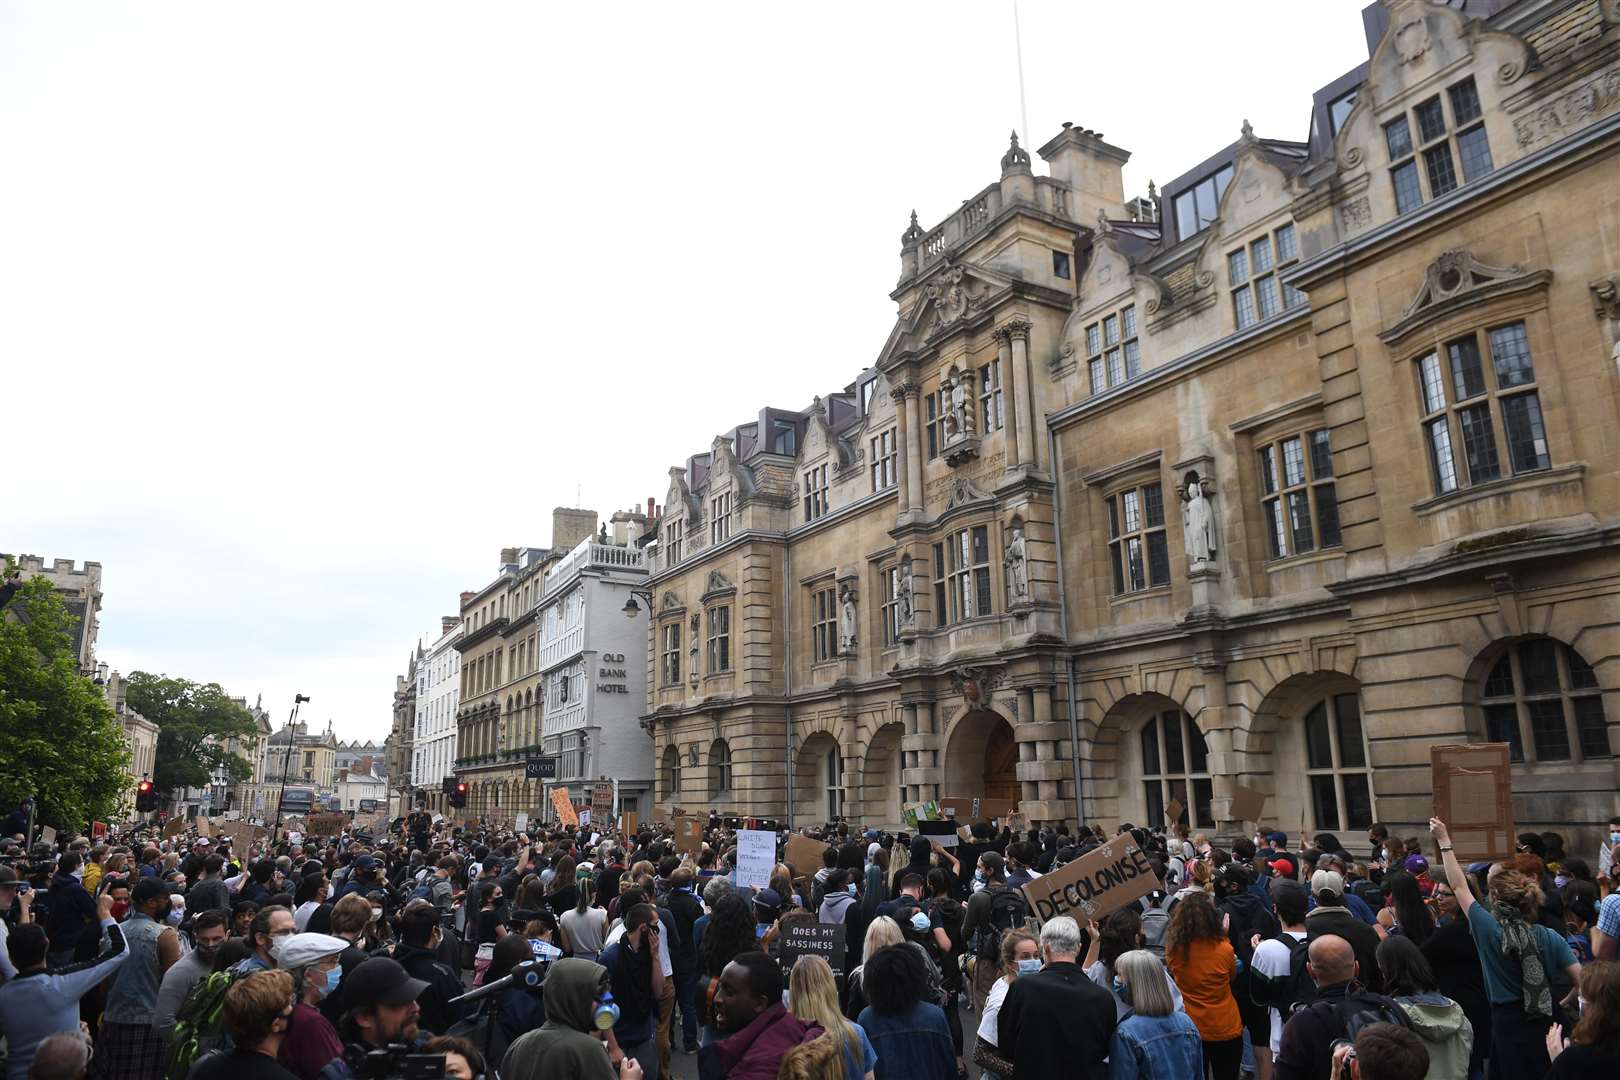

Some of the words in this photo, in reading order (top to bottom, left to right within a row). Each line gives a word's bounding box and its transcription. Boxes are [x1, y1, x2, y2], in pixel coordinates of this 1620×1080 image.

[603, 653, 625, 662] OLD
[600, 669, 626, 678] BANK
[596, 684, 629, 694] HOTEL
[527, 763, 554, 773] QUOD
[1035, 850, 1152, 921] DECOLONISE
[793, 928, 817, 936] DOES
[822, 928, 835, 936] MY
[786, 939, 833, 950] SASSINESS
